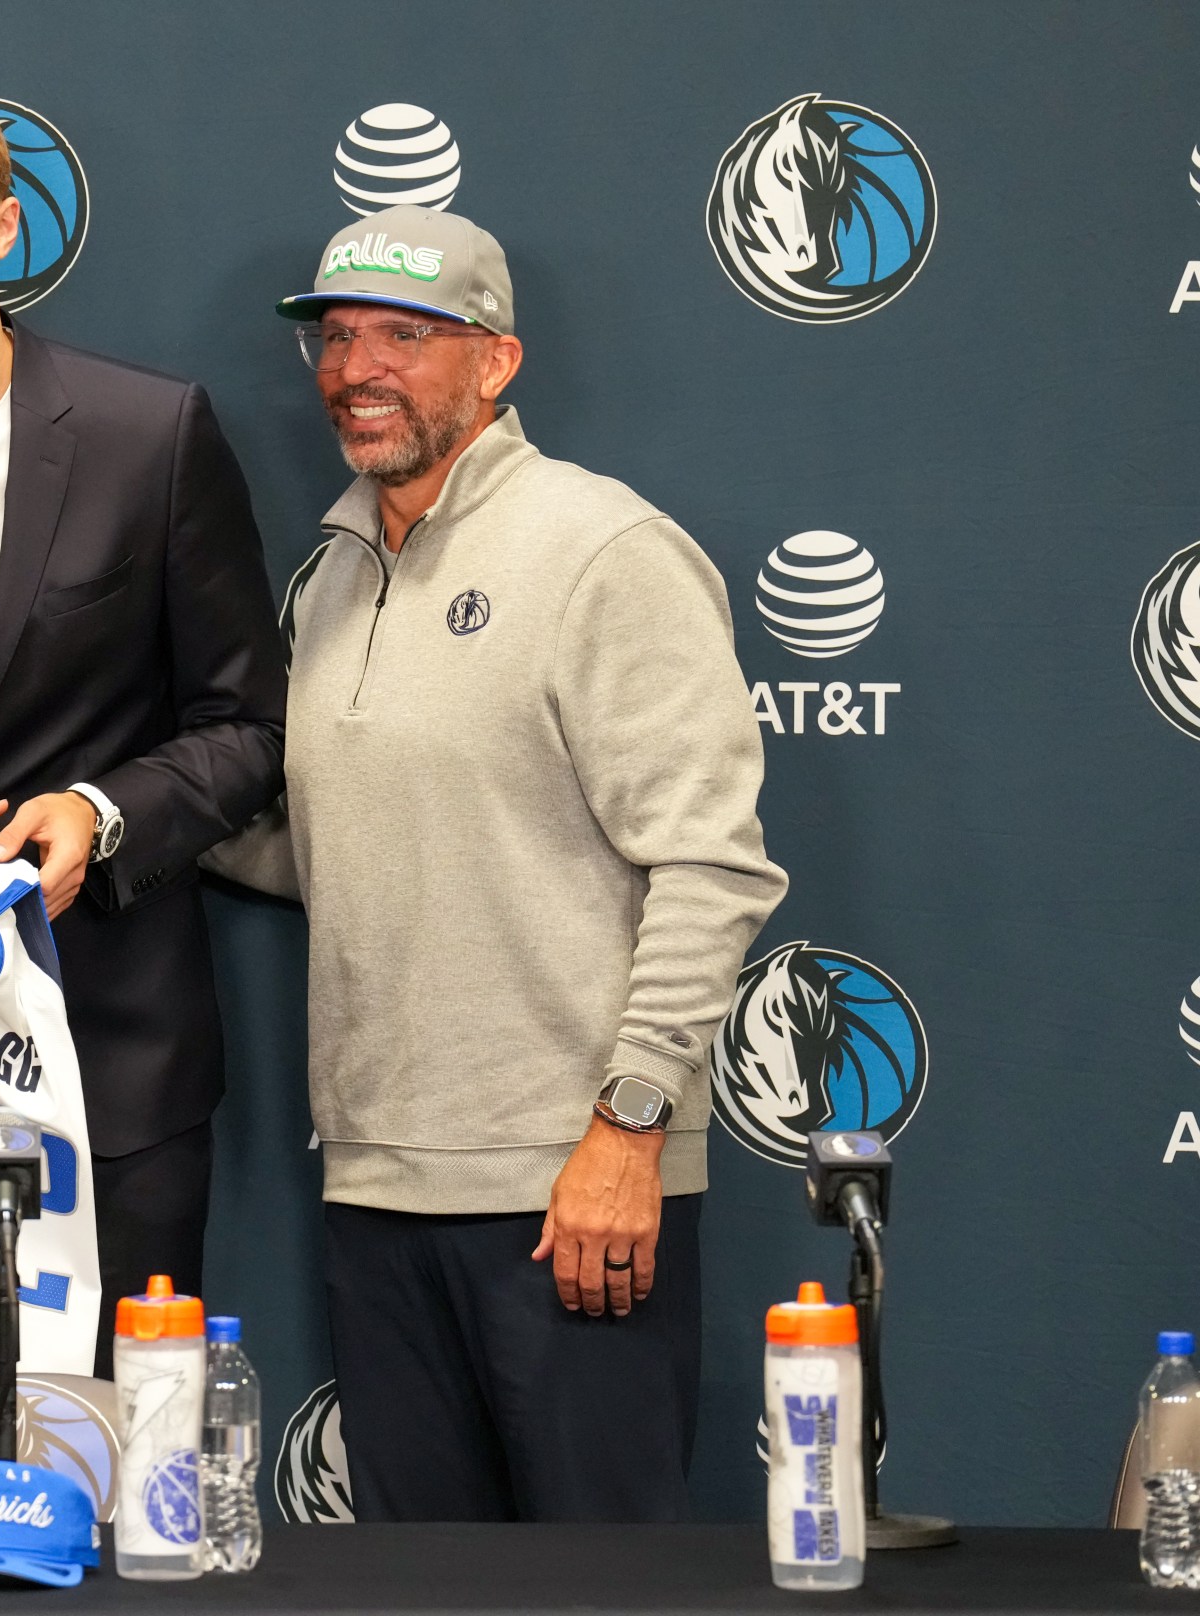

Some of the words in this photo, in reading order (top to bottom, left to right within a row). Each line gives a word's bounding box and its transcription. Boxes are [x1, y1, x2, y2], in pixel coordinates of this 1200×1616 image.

[750, 681, 901, 735] AT&T
[816, 1409, 834, 1490] WHATEVER
[818, 1510, 835, 1556] TAKES
